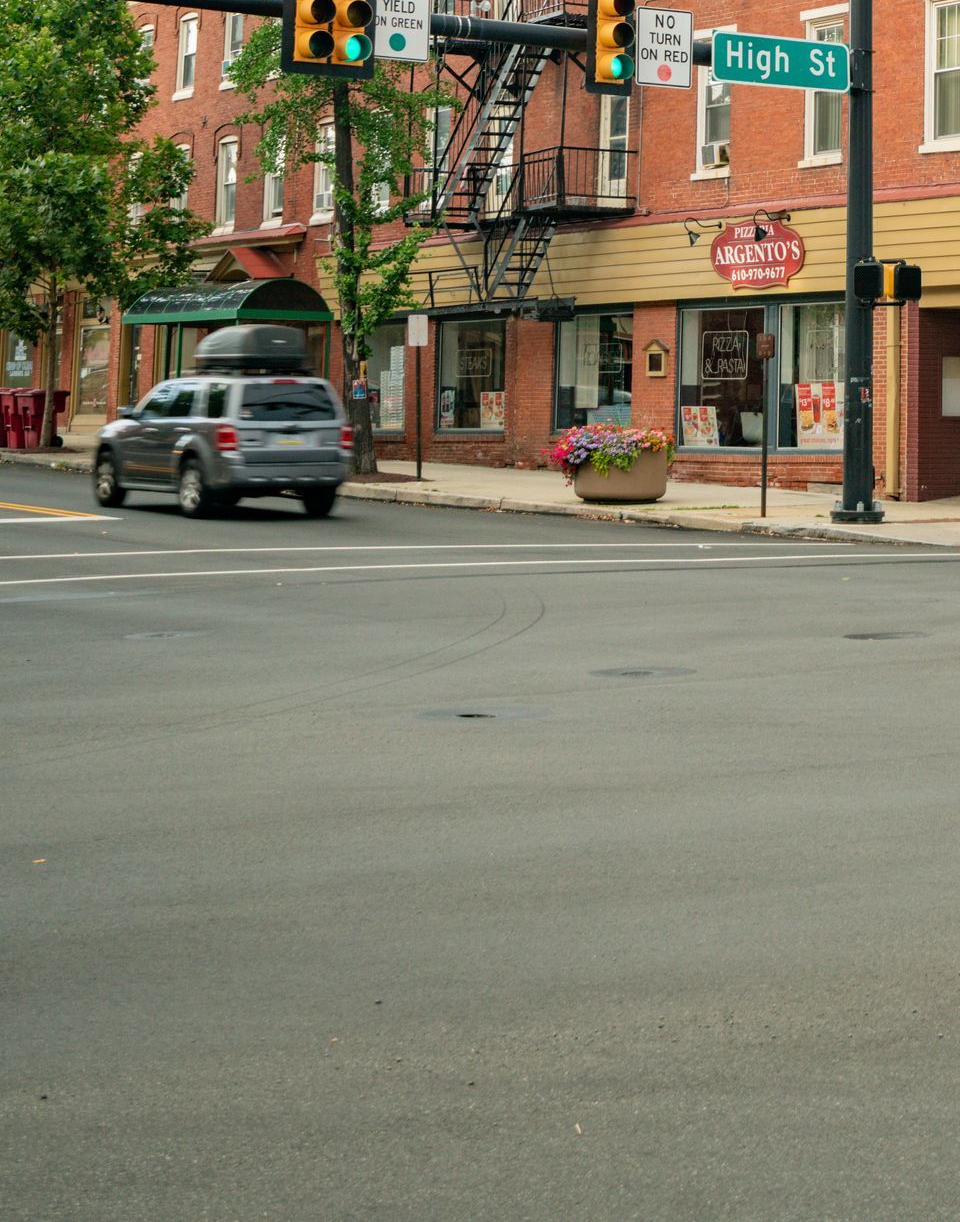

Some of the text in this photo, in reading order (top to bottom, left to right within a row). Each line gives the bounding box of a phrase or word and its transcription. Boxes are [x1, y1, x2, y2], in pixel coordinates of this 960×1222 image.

[391, 17, 423, 30] GREEN
[655, 14, 676, 29] NO
[649, 31, 681, 46] TURN
[640, 47, 689, 63] ON RED
[726, 40, 836, 80] High St
[714, 240, 800, 265] ARGENTO'S
[731, 267, 785, 281] 610-970-9677
[712, 336, 740, 353] PIZZA
[717, 358, 745, 374] PASTA
